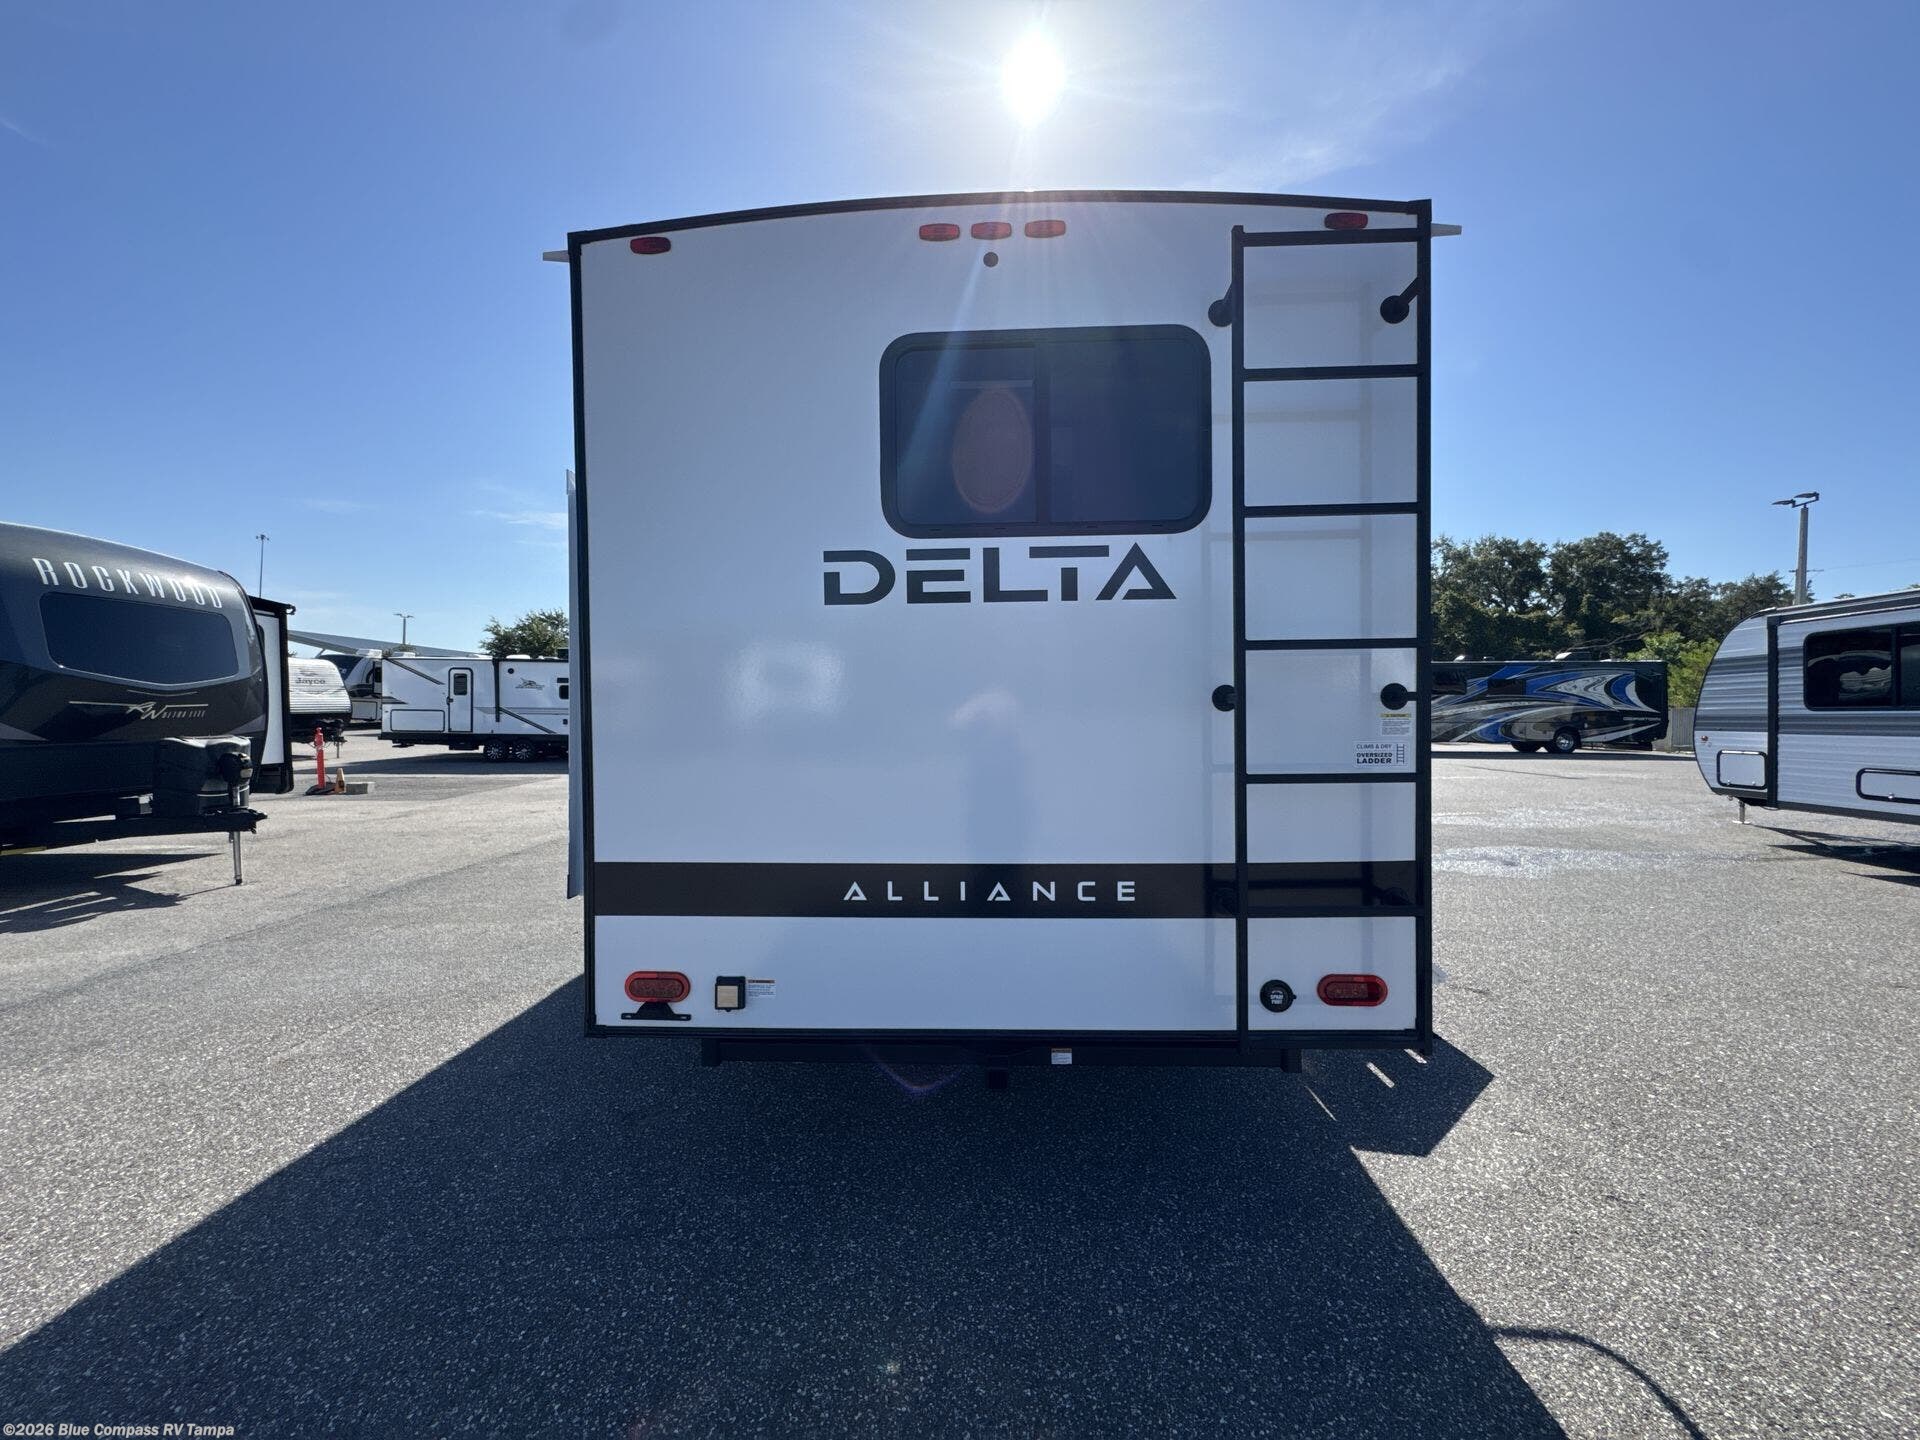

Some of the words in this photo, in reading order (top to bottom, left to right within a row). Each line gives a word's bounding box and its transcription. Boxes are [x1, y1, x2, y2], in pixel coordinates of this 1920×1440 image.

[32, 557, 223, 609] ROCKWOOD
[823, 542, 1177, 605] DELTA
[295, 677, 326, 685] Jayco
[843, 880, 1136, 902] ALLIANCE
